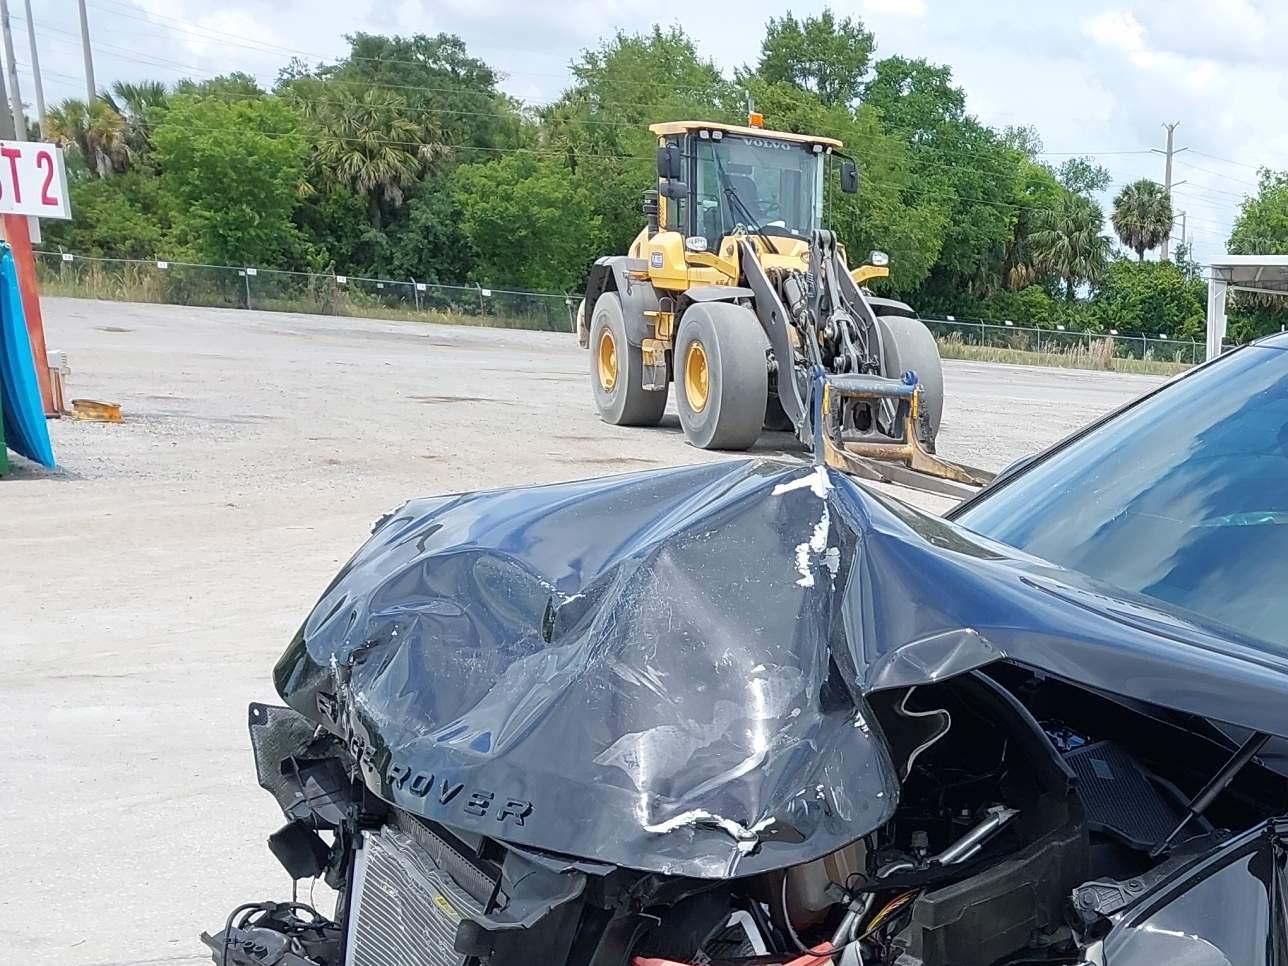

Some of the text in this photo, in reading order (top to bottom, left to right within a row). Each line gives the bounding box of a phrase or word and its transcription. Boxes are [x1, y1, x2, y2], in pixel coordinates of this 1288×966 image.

[743, 139, 791, 150] VOLVO
[0, 147, 59, 206] T 2
[386, 764, 535, 827] ROVER
